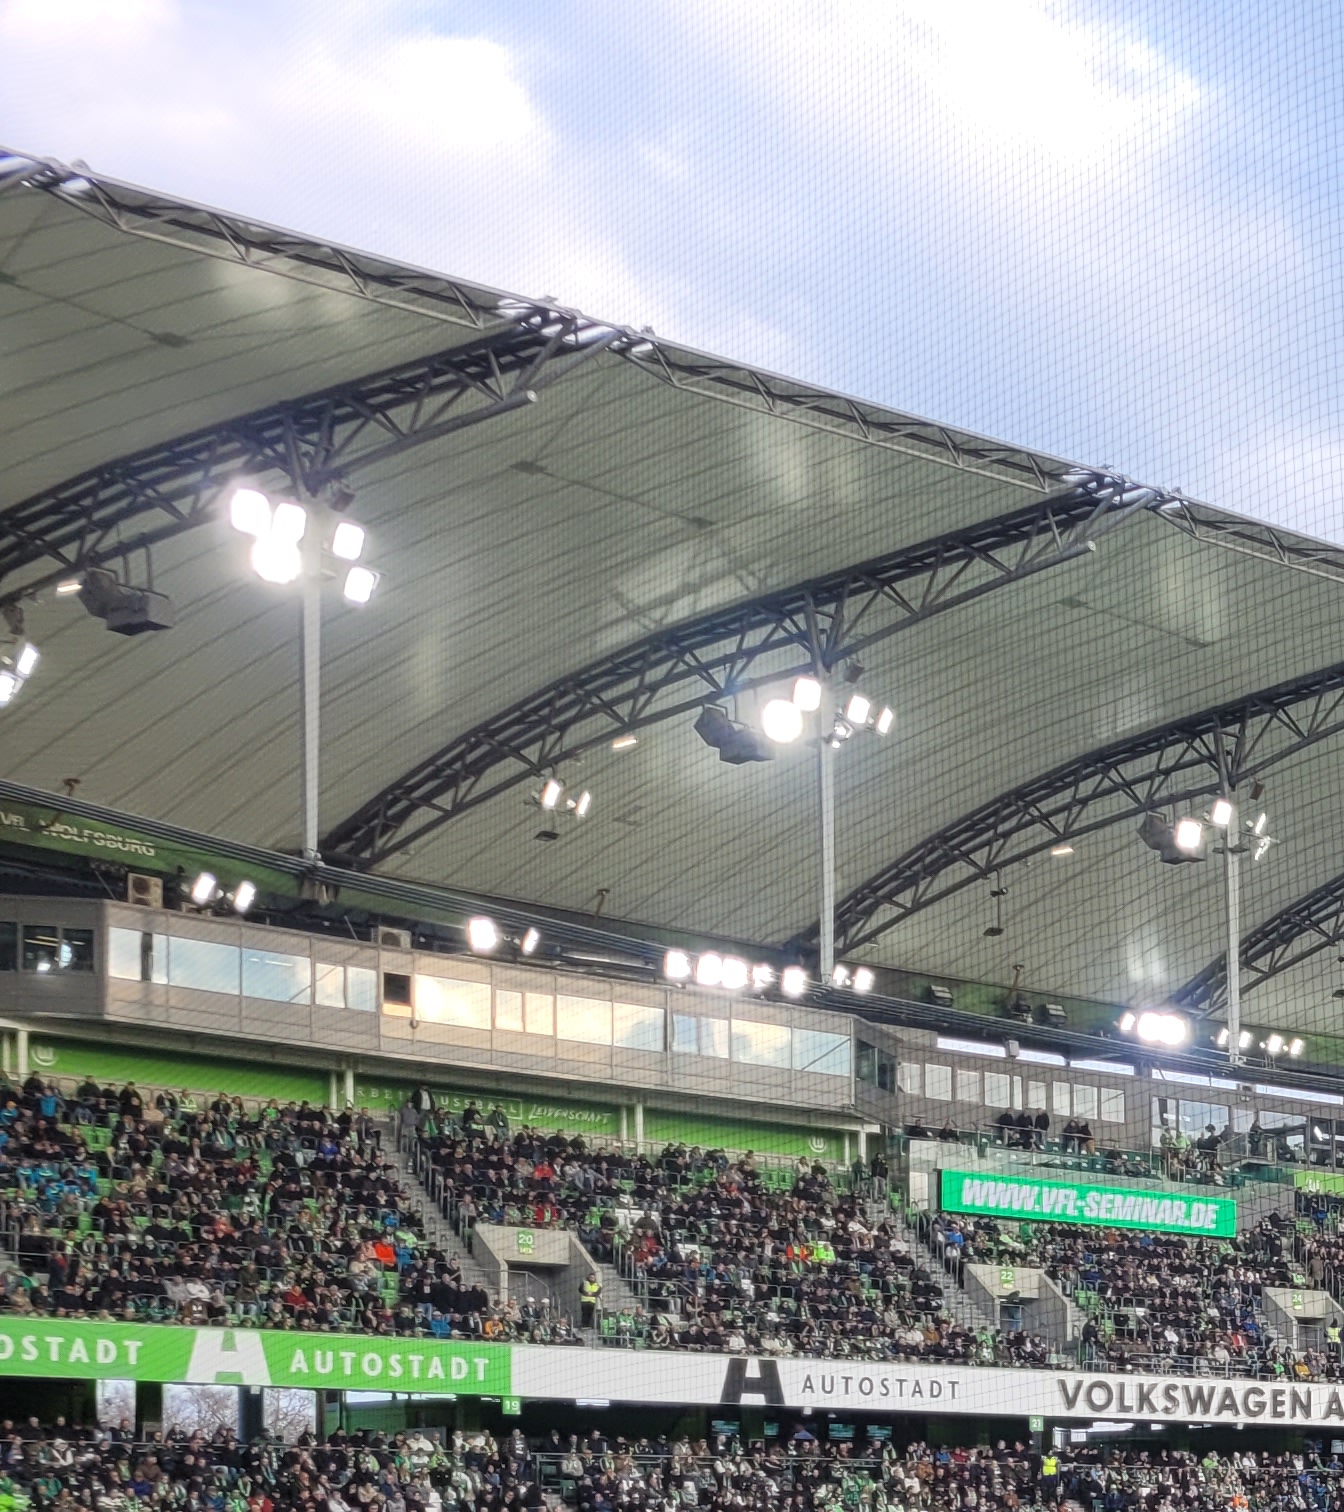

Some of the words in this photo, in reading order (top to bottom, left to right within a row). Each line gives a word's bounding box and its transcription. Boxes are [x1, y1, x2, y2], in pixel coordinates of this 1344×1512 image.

[961, 1179, 1220, 1230] WWW.VFL-SEMINAR.DE
[518, 1233, 534, 1245] 20
[290, 1348, 490, 1381] AUTOSTADT
[802, 1374, 960, 1400] AUTOSTADT
[1057, 1378, 1312, 1420] VOLKSWAGEN
[505, 1400, 519, 1410] 19
